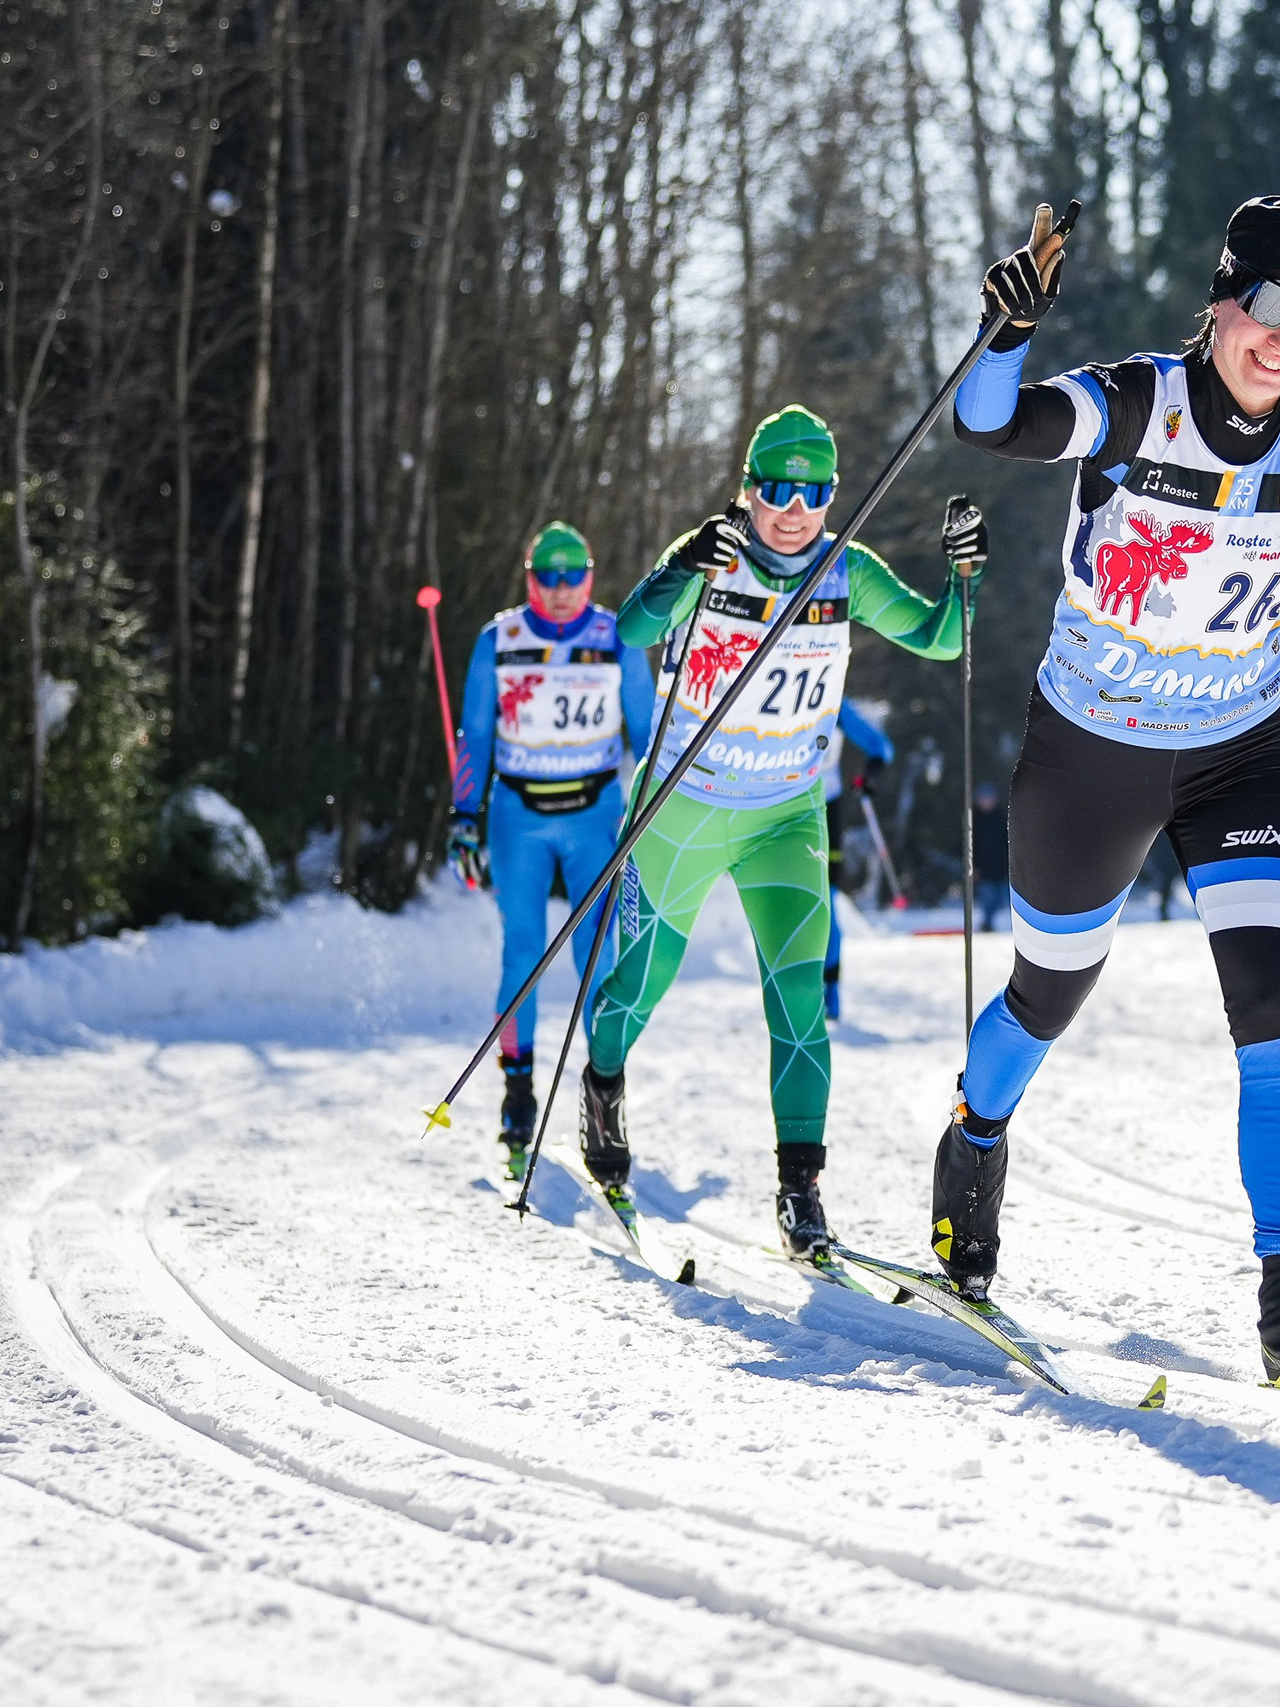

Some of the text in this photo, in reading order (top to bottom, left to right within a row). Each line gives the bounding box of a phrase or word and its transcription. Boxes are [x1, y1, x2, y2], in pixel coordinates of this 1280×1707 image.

[1162, 483, 1199, 500] Rostec
[1234, 478, 1255, 496] 25
[1228, 497, 1249, 510] KM
[1225, 534, 1272, 549] Rostec
[725, 603, 751, 616] Rostec
[771, 640, 802, 650] ostec
[1055, 655, 1093, 686] BIVIUM
[758, 662, 834, 718] 216
[553, 695, 606, 730] 346
[1140, 721, 1190, 731] MADSHUS
